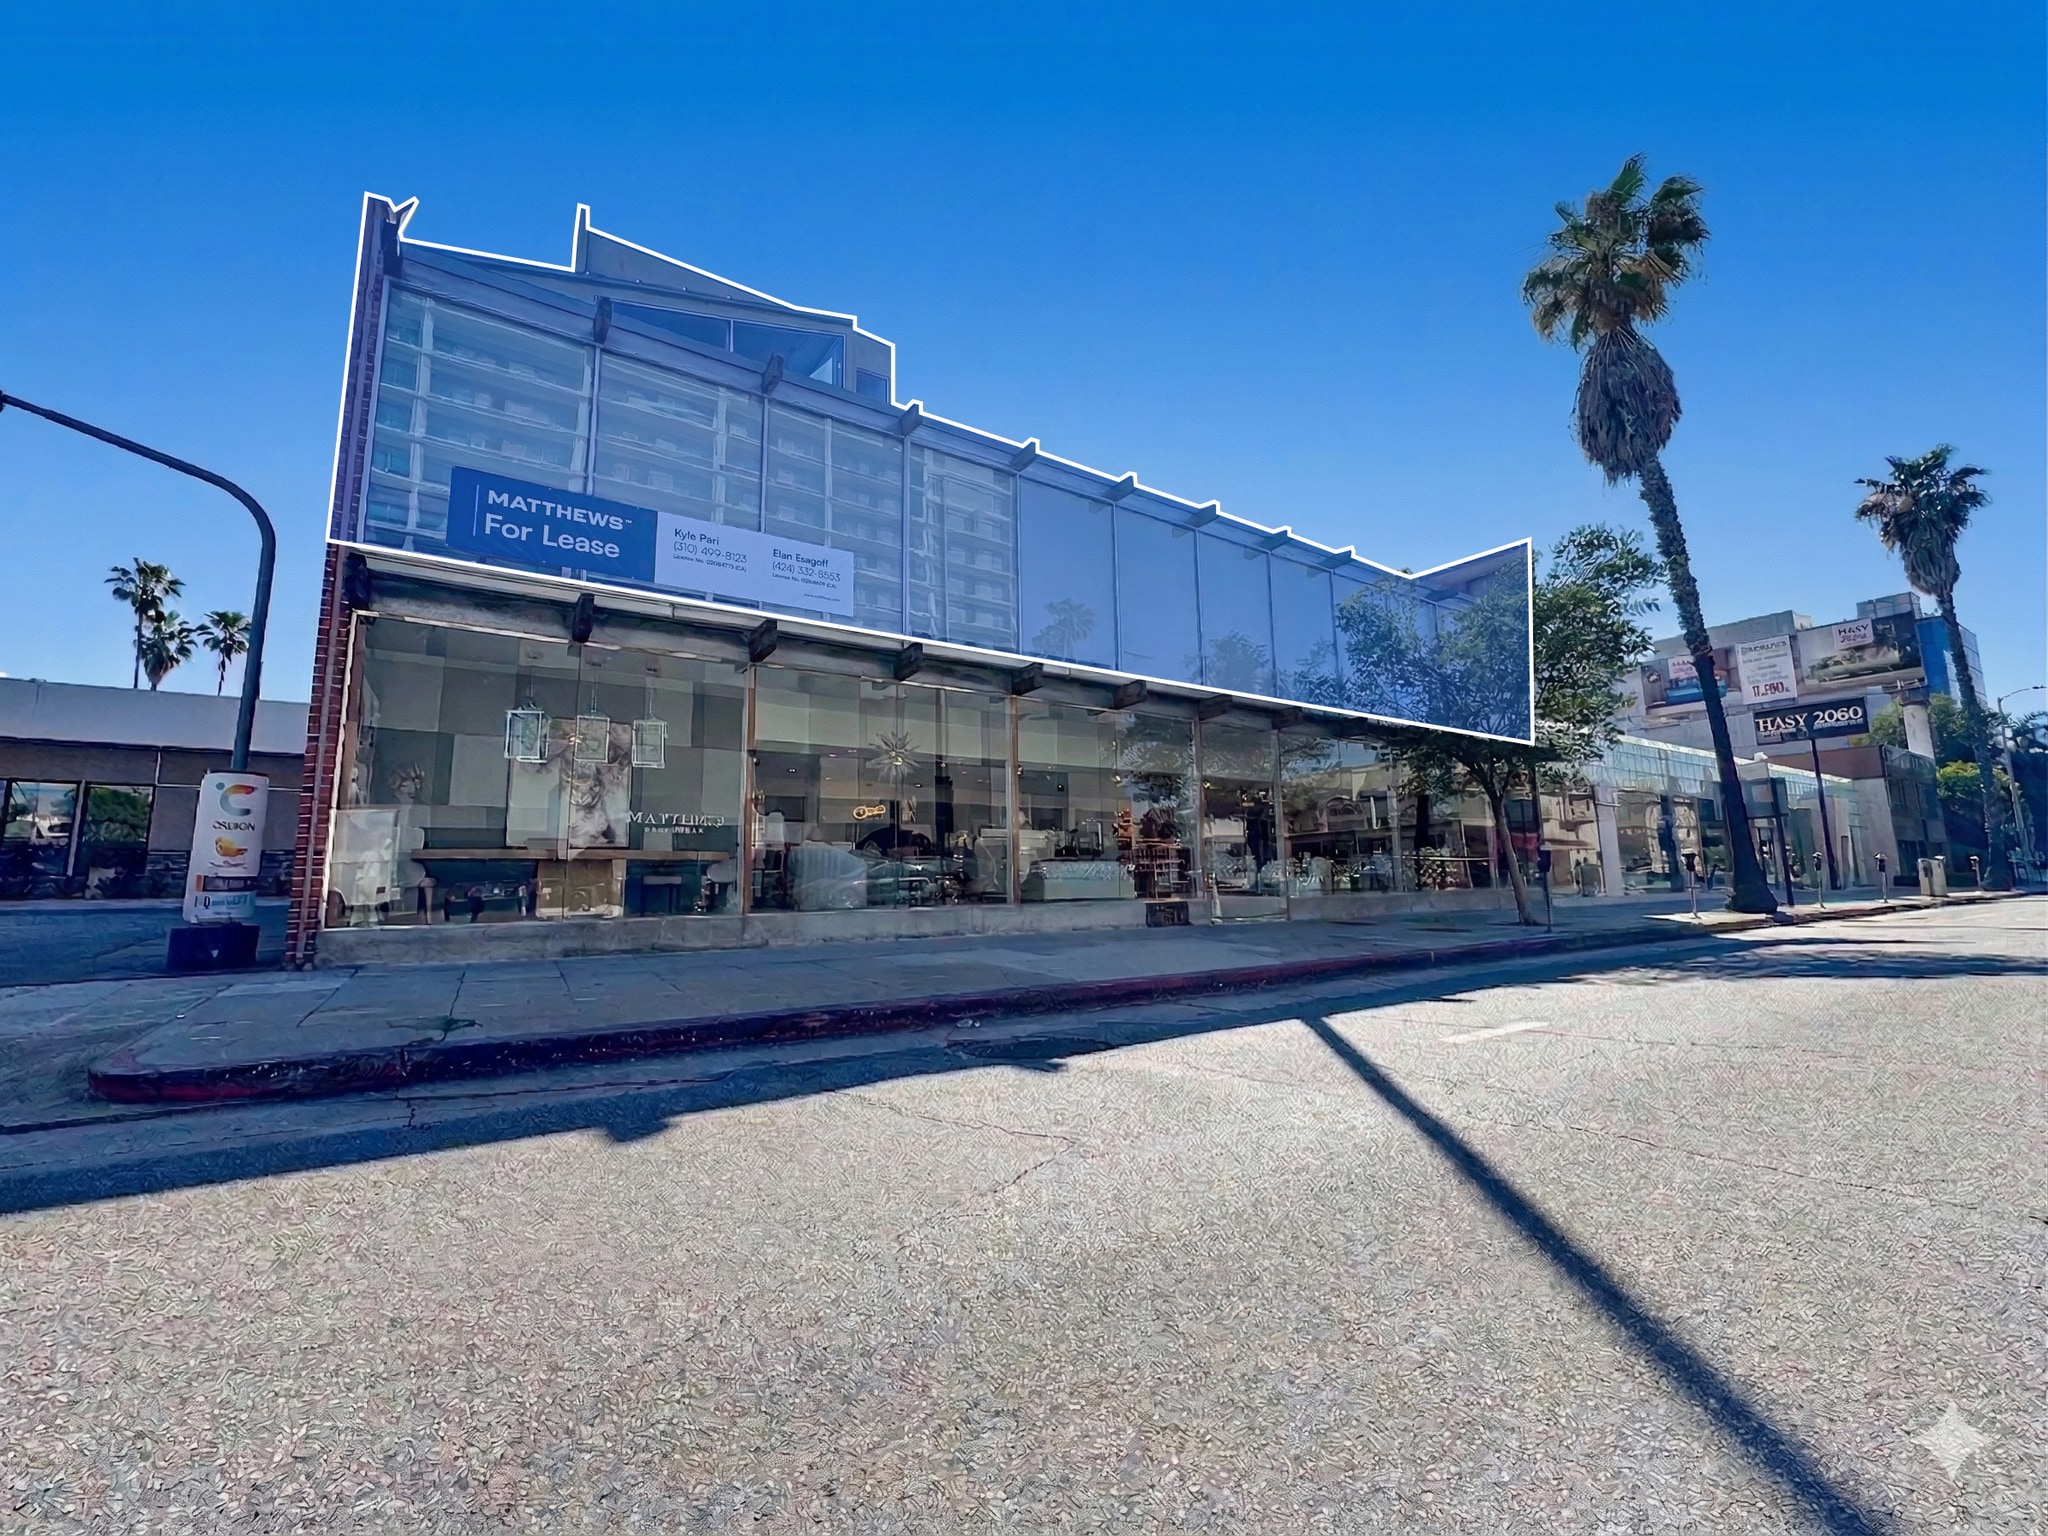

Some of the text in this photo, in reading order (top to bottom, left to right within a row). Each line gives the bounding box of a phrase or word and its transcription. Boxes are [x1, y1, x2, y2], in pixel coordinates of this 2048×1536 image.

[484, 512, 620, 558] For Lease
[674, 528, 719, 545] Kyle Pari
[673, 541, 748, 563] (310) 499-8123
[773, 548, 829, 568] Elan Esagoff
[772, 561, 841, 582] (424) 332-8553
[1755, 713, 1808, 732] HASY
[1812, 705, 1863, 723] 2060
